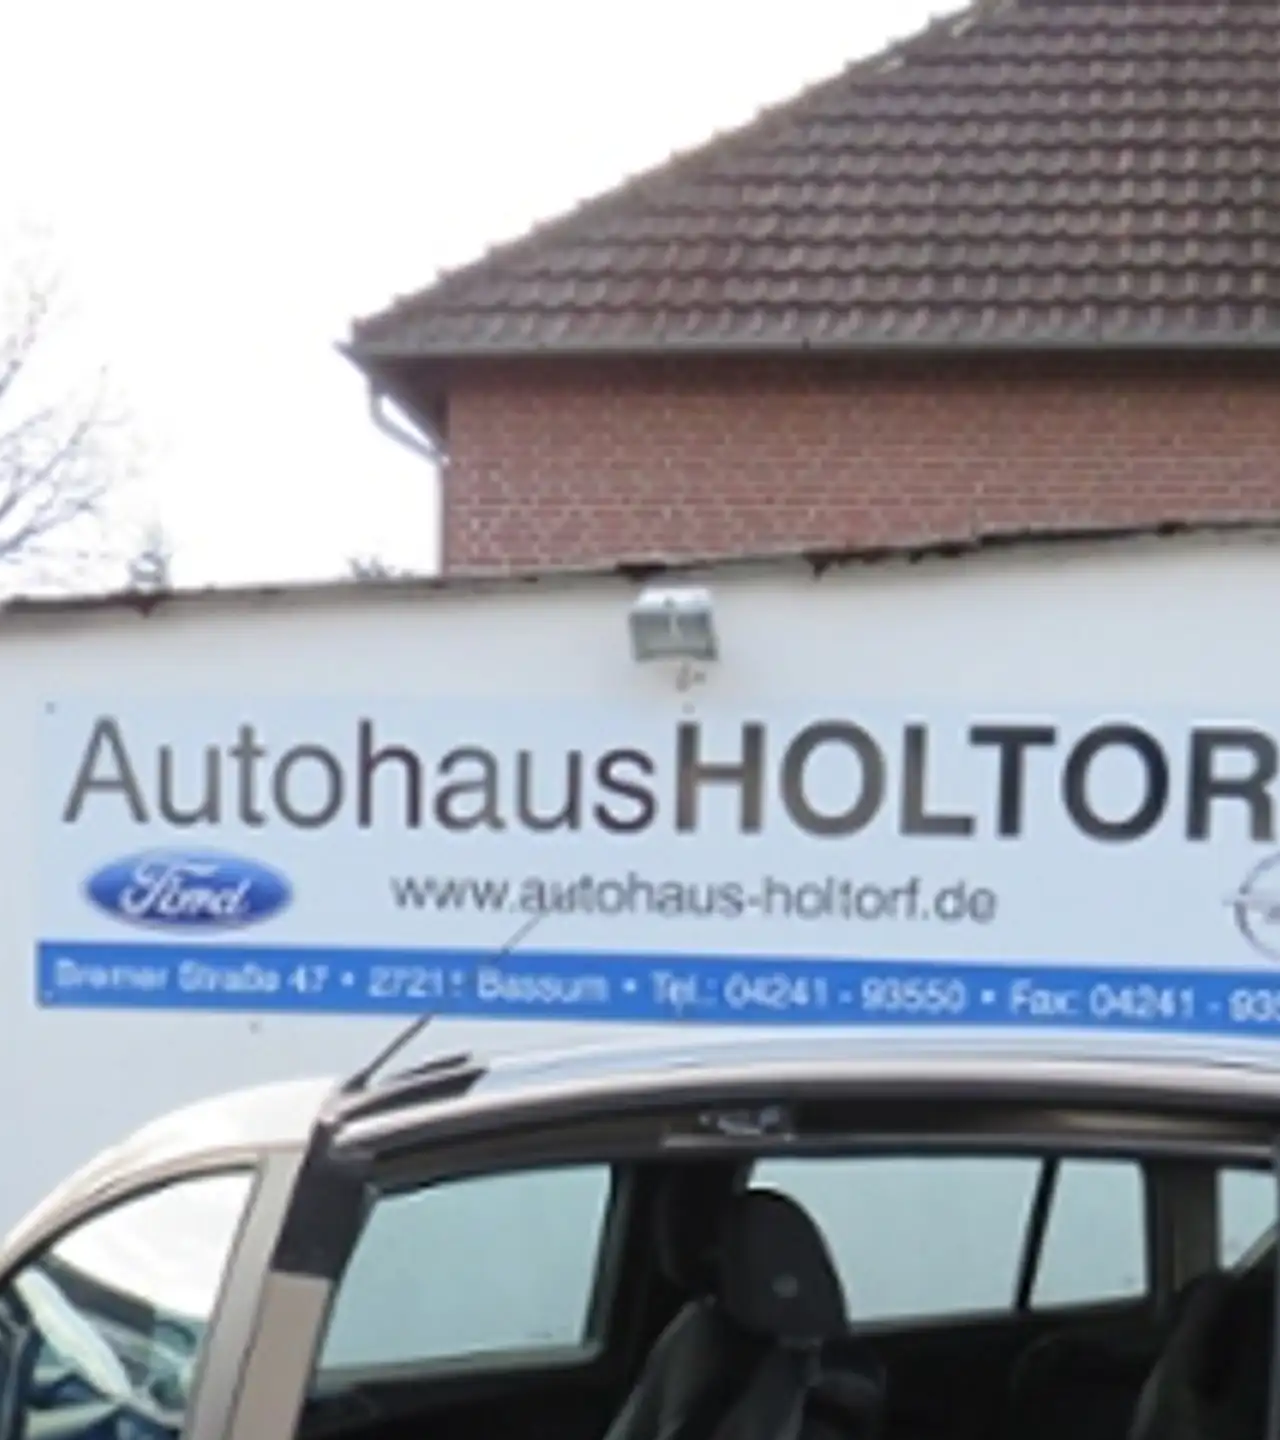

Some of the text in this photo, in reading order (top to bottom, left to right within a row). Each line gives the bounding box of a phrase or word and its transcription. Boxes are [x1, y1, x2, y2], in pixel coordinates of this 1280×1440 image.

[117, 859, 251, 917] Ford
[390, 871, 999, 924] www.autohaus-holtorf.de
[55, 958, 168, 989] Bremer
[287, 963, 329, 994] 47
[477, 966, 609, 1003] Bassum
[724, 972, 827, 1010] 04241
[861, 976, 966, 1014] 93550
[1090, 983, 1194, 1018] 04241
